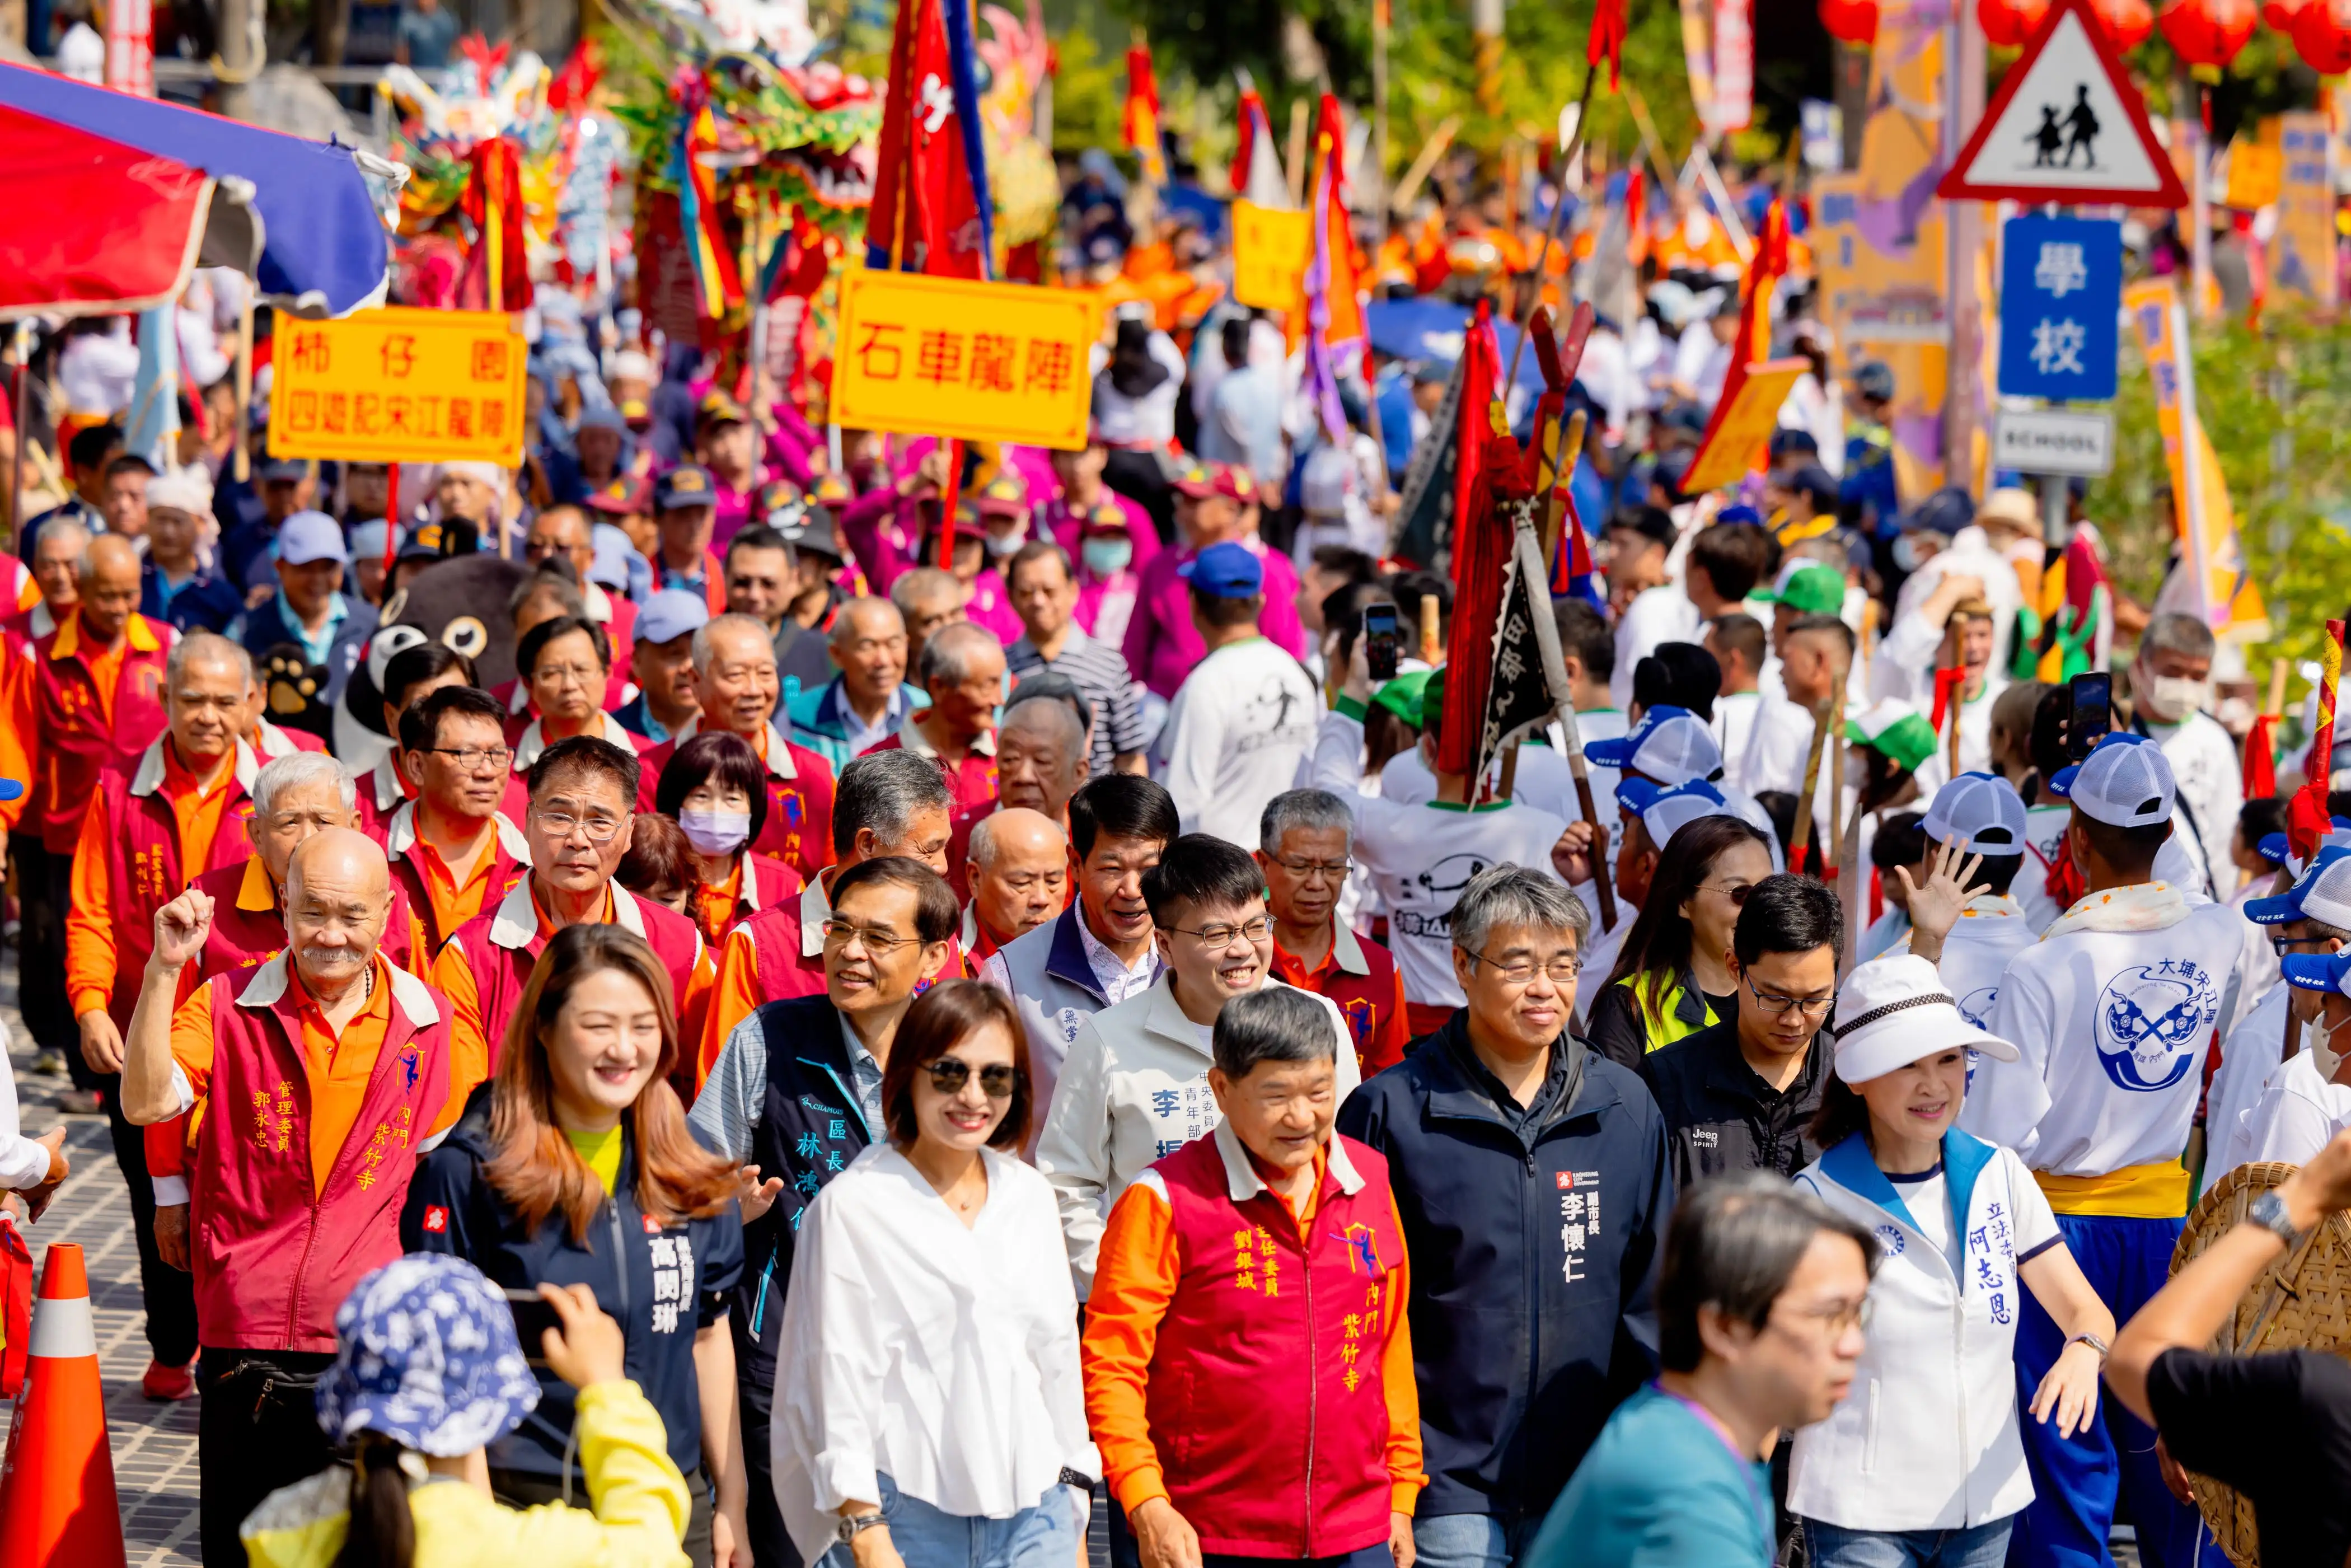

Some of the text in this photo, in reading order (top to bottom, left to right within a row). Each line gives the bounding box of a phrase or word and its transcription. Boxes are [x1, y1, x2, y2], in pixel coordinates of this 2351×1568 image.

[2030, 242, 2087, 375] 學校
[856, 321, 1073, 397] 石車龍陣
[2005, 430, 2099, 452] SCHOOL
[2158, 957, 2218, 1024] 大埔宋江陣
[252, 1089, 271, 1148] 郭永忠
[276, 1080, 294, 1153] 管理委員
[390, 1102, 411, 1150] 內門
[1185, 1087, 1201, 1138] 青年部
[1200, 1071, 1214, 1127] 中央委員
[355, 1122, 391, 1191] 紫竹寺
[826, 1120, 846, 1171] 區長
[1692, 1129, 1718, 1141] Jeep
[1561, 1192, 1585, 1283] 李懷仁
[1586, 1191, 1600, 1235] 副市長
[1364, 1282, 1379, 1335] 內門
[1340, 1312, 1361, 1392] 紫竹寺
